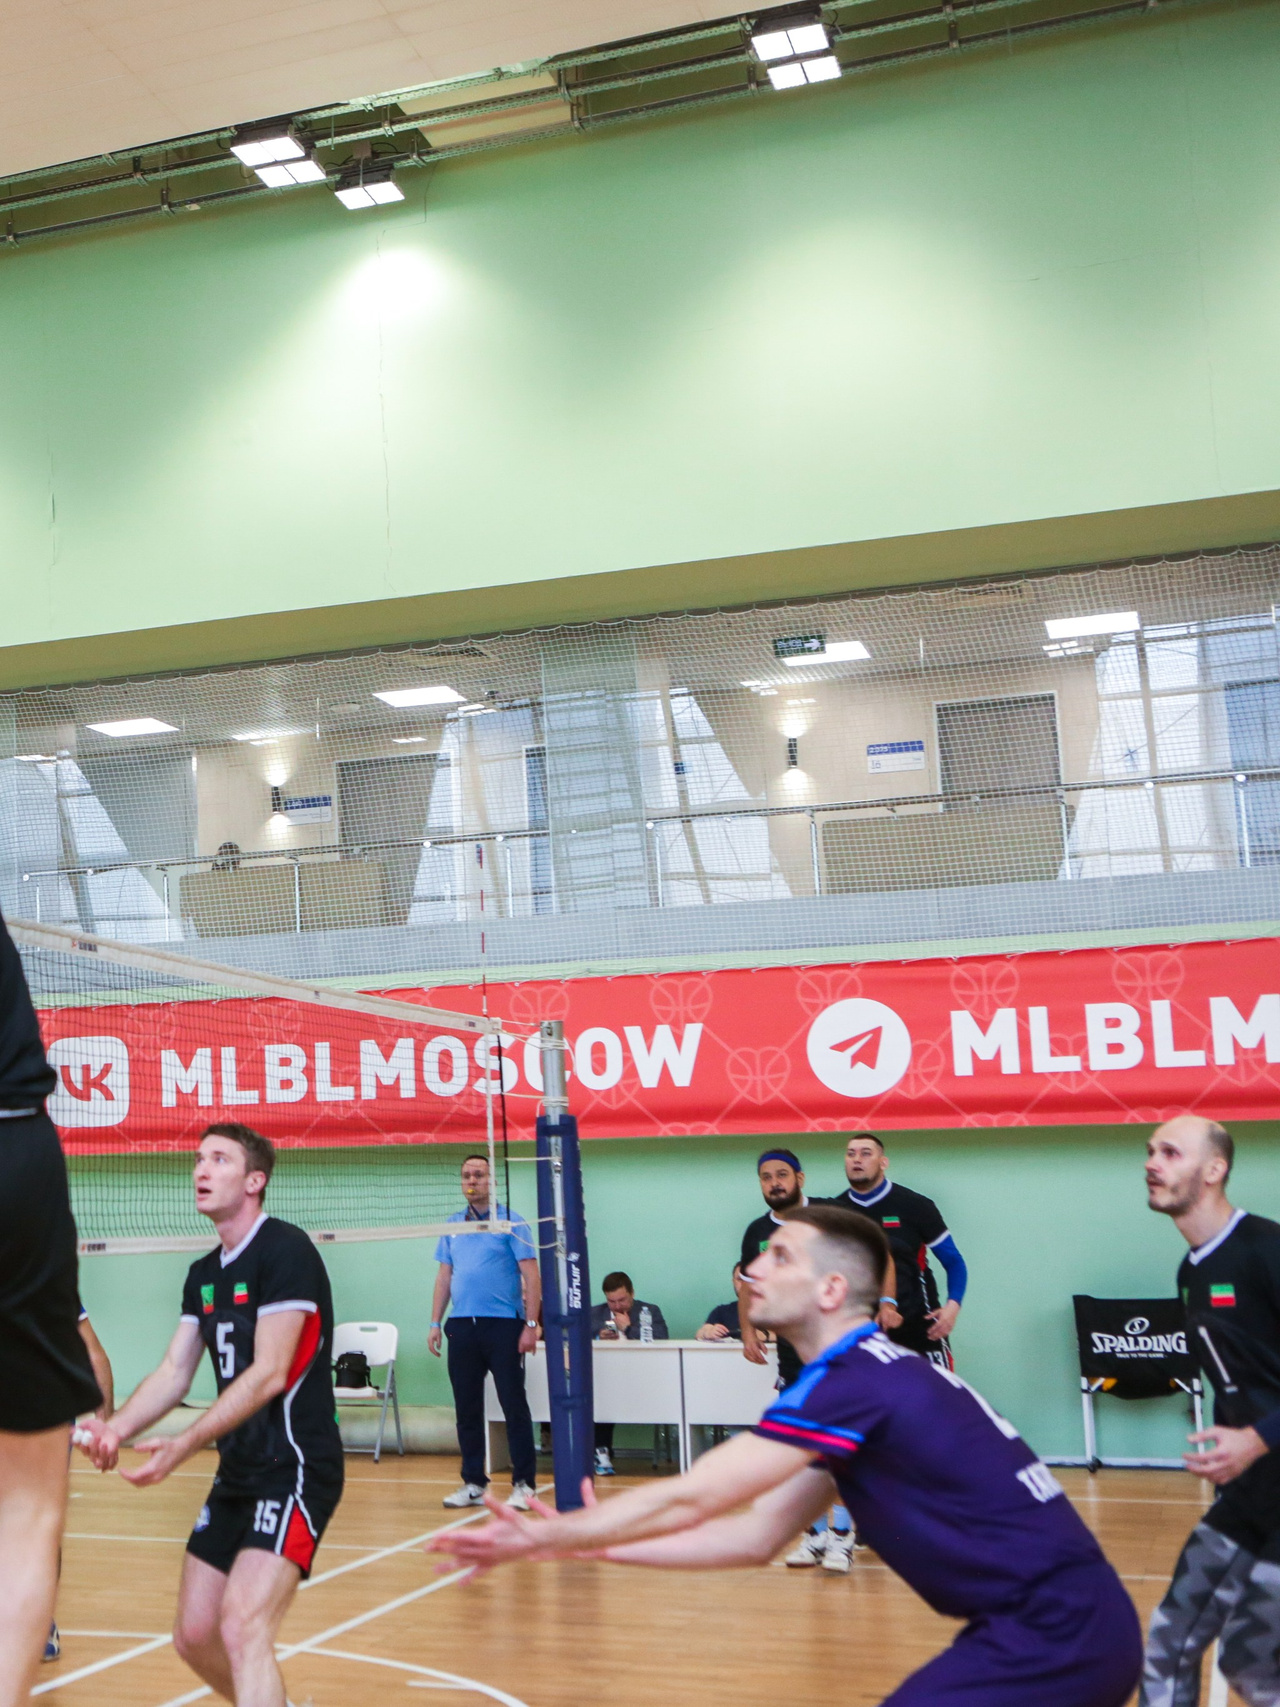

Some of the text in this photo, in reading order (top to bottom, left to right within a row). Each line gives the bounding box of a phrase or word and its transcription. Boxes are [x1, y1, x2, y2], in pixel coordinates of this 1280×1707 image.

[160, 1022, 704, 1108] MLBLMOSCOW
[949, 993, 1280, 1077] MLBLM
[216, 1321, 236, 1389] 5
[1091, 1331, 1190, 1354] SPALDING
[253, 1499, 281, 1535] 15
